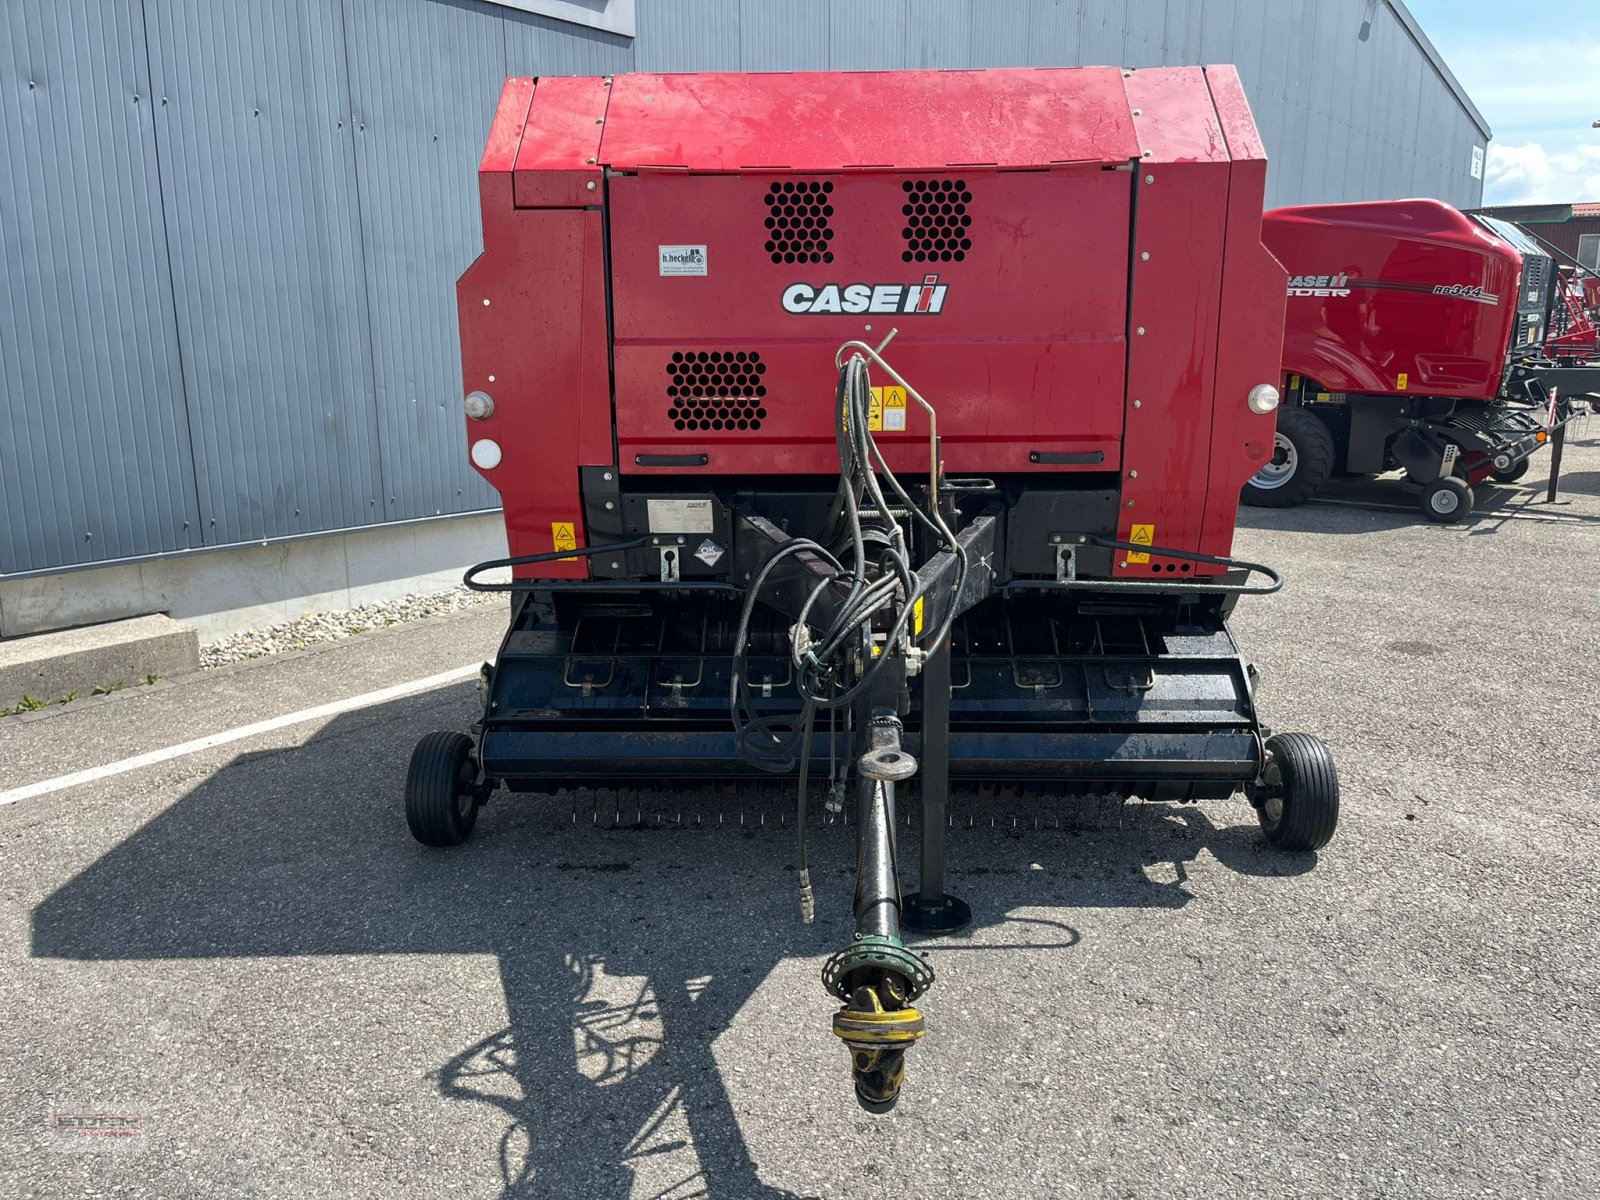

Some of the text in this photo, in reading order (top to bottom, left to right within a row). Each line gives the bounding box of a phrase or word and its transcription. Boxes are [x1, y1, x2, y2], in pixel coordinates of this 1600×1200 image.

[781, 274, 948, 315] CASE IH
[700, 545, 715, 554] OK
